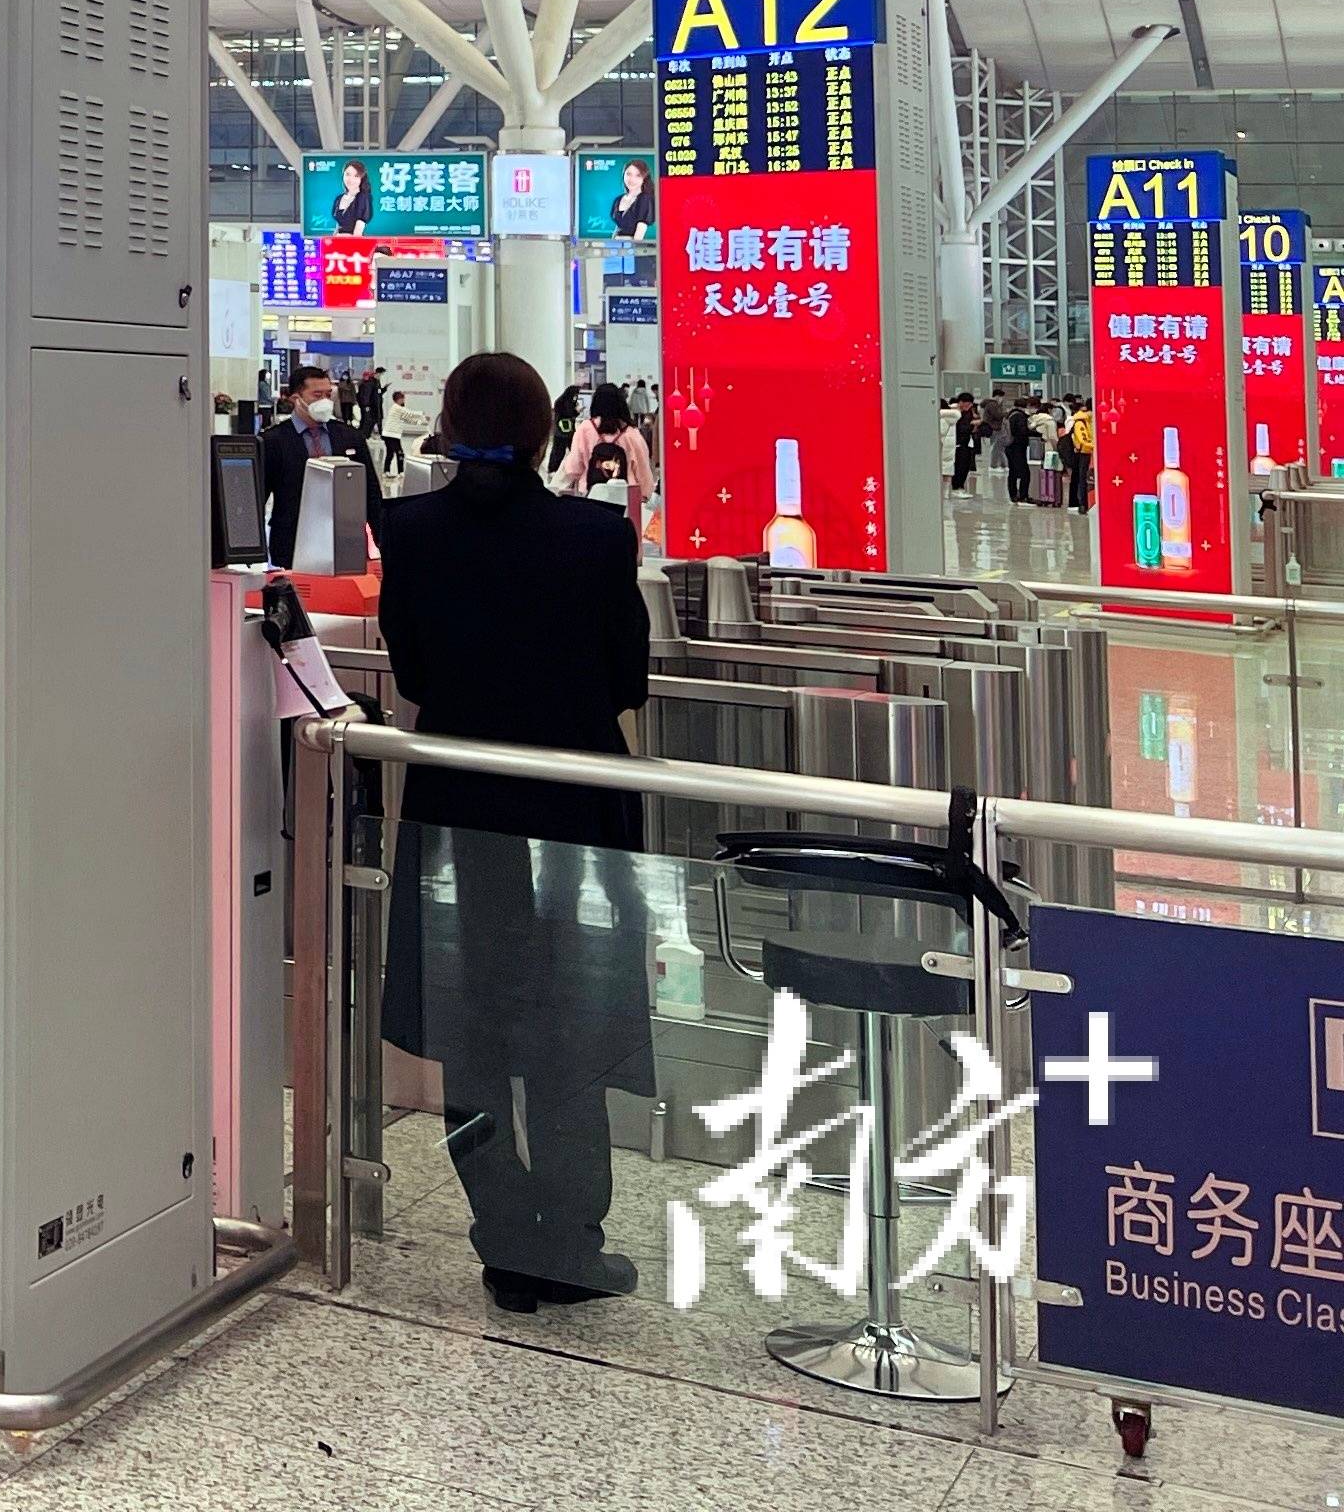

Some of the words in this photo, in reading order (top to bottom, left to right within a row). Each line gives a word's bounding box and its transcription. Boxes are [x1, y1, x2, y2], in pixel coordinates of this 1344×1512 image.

[379, 161, 480, 193] 好莱客
[1098, 171, 1199, 220] A11
[379, 195, 480, 212] 定制家居大师
[685, 225, 851, 272] 健康有请
[703, 281, 833, 319] 天地壹号
[1108, 314, 1208, 340] 健康有请
[1119, 344, 1198, 365] 天地壹号
[1105, 1160, 1344, 1282] 商务座
[1105, 1259, 1266, 1320] Business
